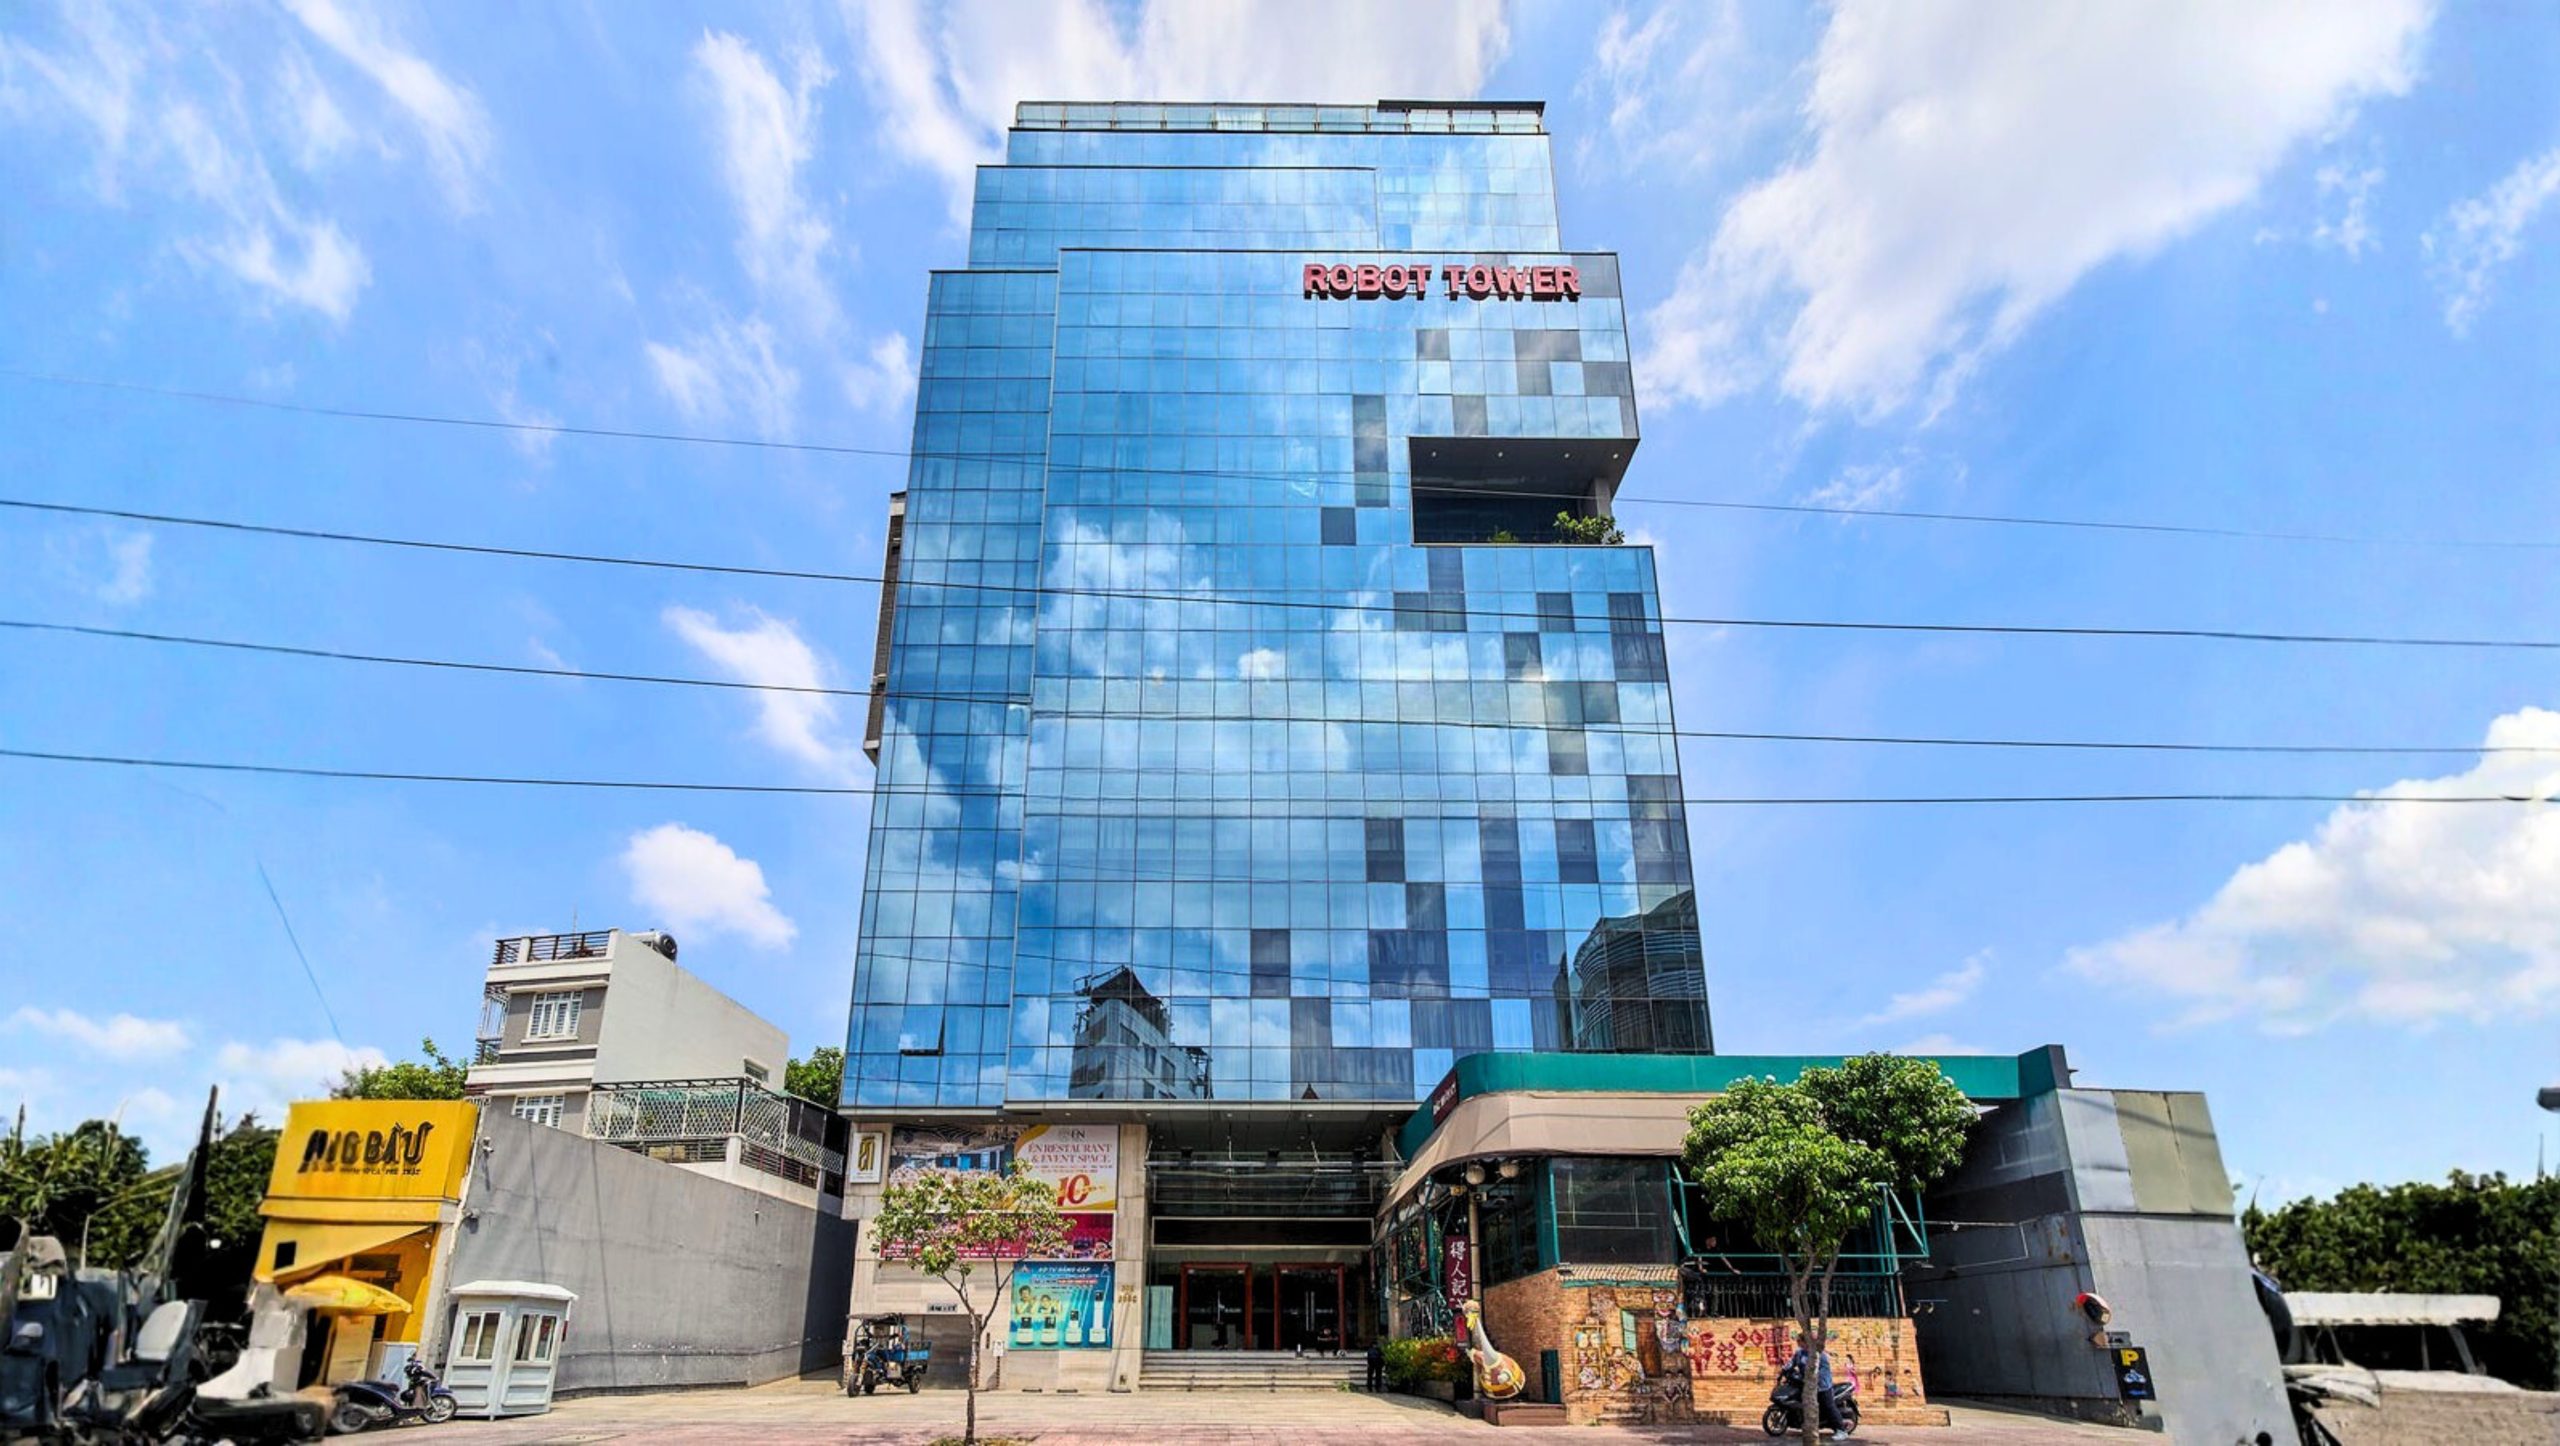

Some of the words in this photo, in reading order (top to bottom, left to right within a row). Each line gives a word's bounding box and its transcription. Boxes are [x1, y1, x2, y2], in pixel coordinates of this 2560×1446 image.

[1303, 264, 1432, 299] ROBOT
[1442, 265, 1581, 301] TOWER
[1043, 1143, 1113, 1153] RESTAURANT
[1041, 1154, 1076, 1163] EVENT
[1057, 1174, 1090, 1207] 10
[2120, 1349, 2139, 1366] P
